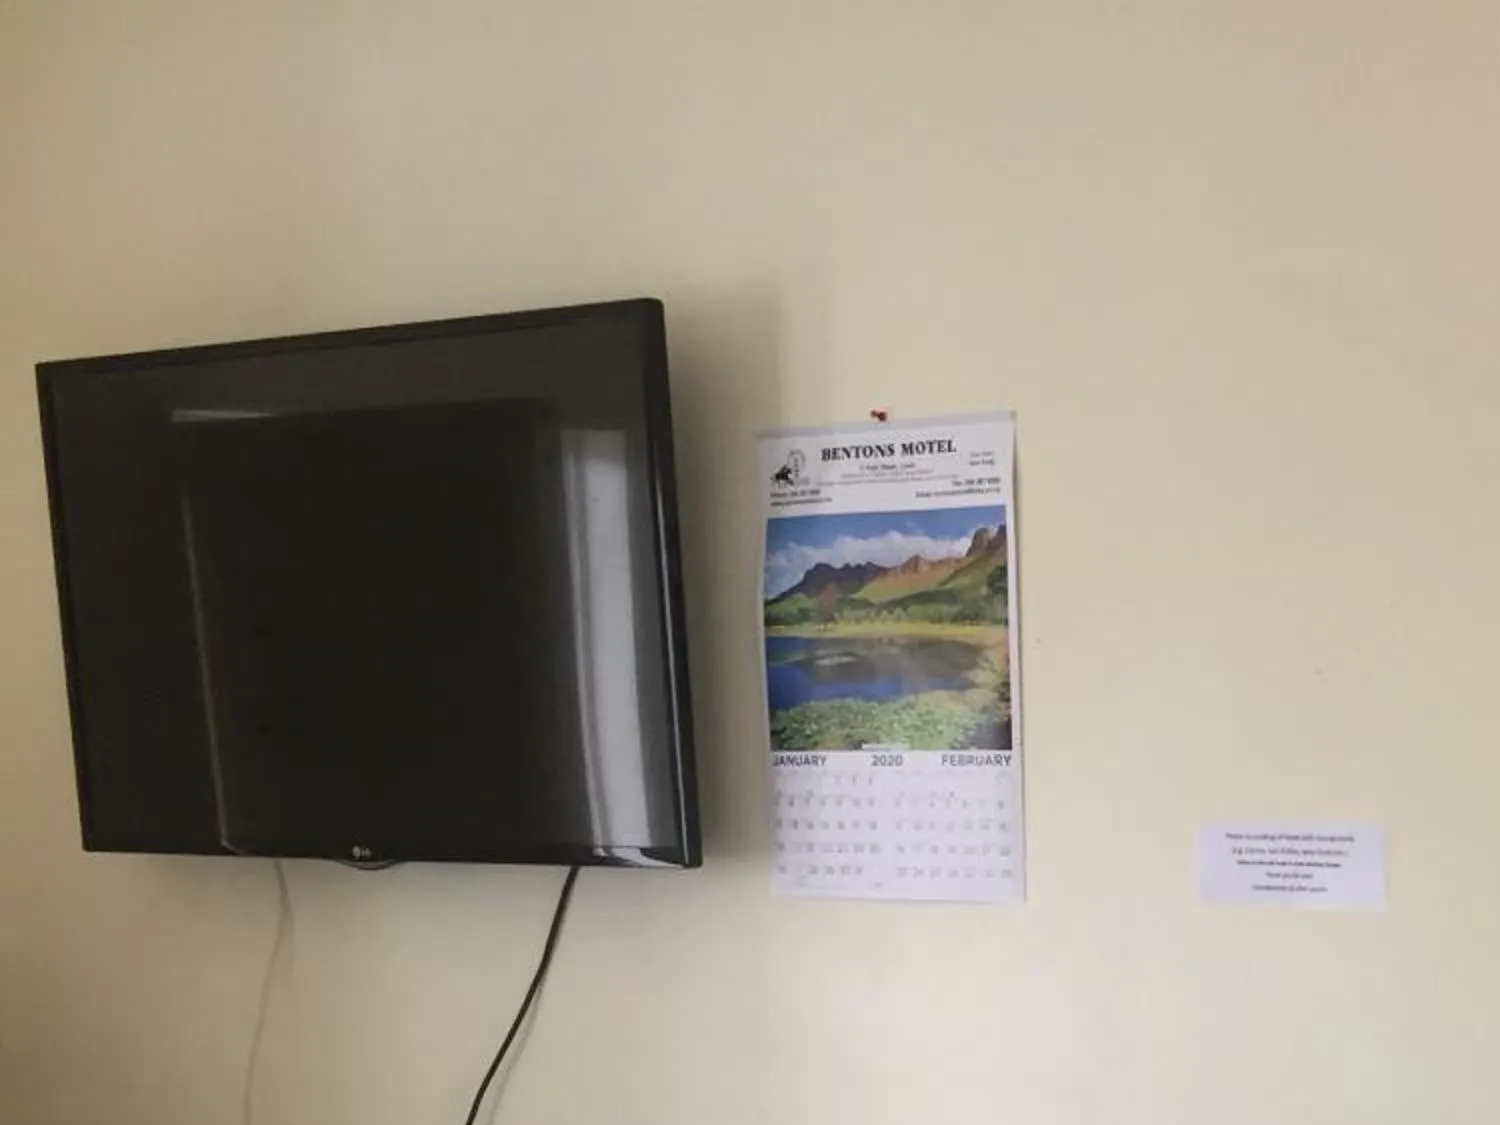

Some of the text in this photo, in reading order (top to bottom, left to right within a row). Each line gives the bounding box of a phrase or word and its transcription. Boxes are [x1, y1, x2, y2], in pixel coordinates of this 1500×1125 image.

[821, 443, 895, 462] BENTONS
[901, 439, 957, 457] MOTEL
[772, 754, 1012, 767] JANUARY 2020 FEBRUARY
